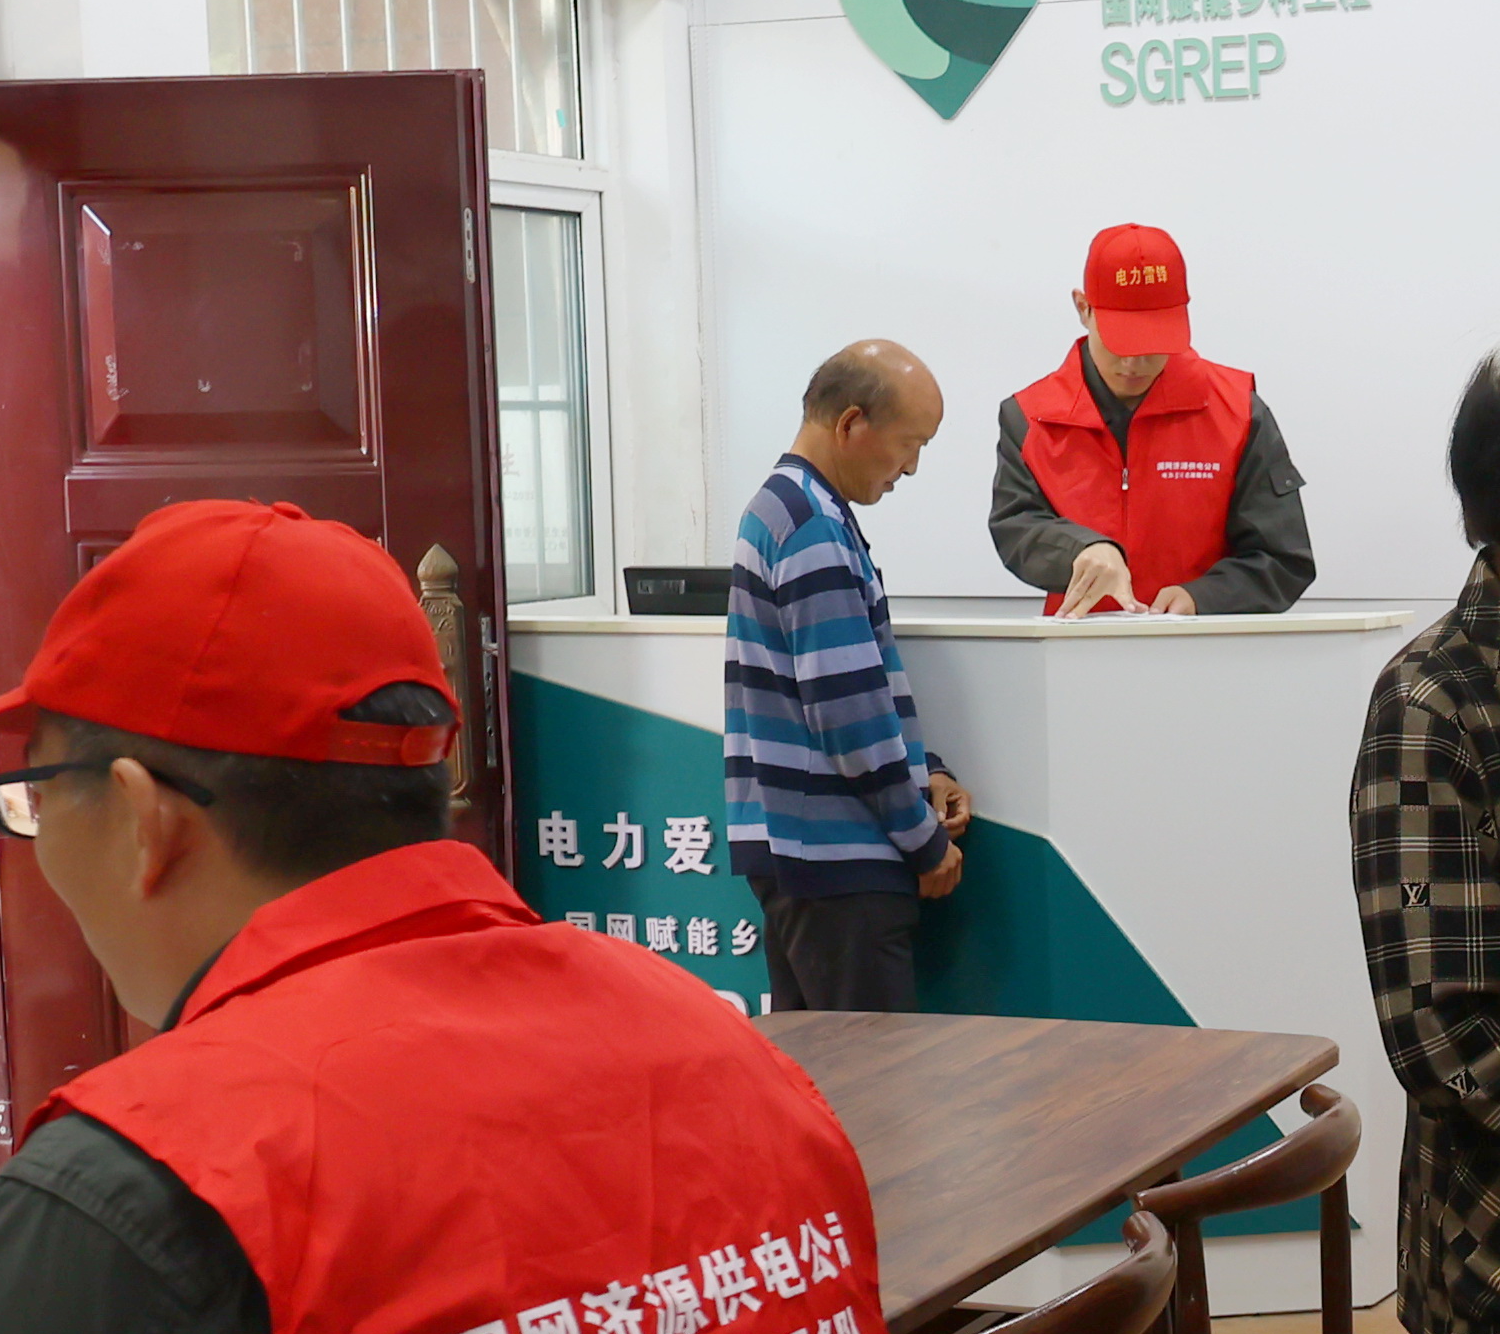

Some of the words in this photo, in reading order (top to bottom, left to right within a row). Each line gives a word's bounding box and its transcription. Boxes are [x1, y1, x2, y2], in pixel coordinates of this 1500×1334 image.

[1100, 32, 1286, 105] SGREP
[1115, 265, 1168, 287] 电力雷锋
[537, 810, 715, 875] 电力爱
